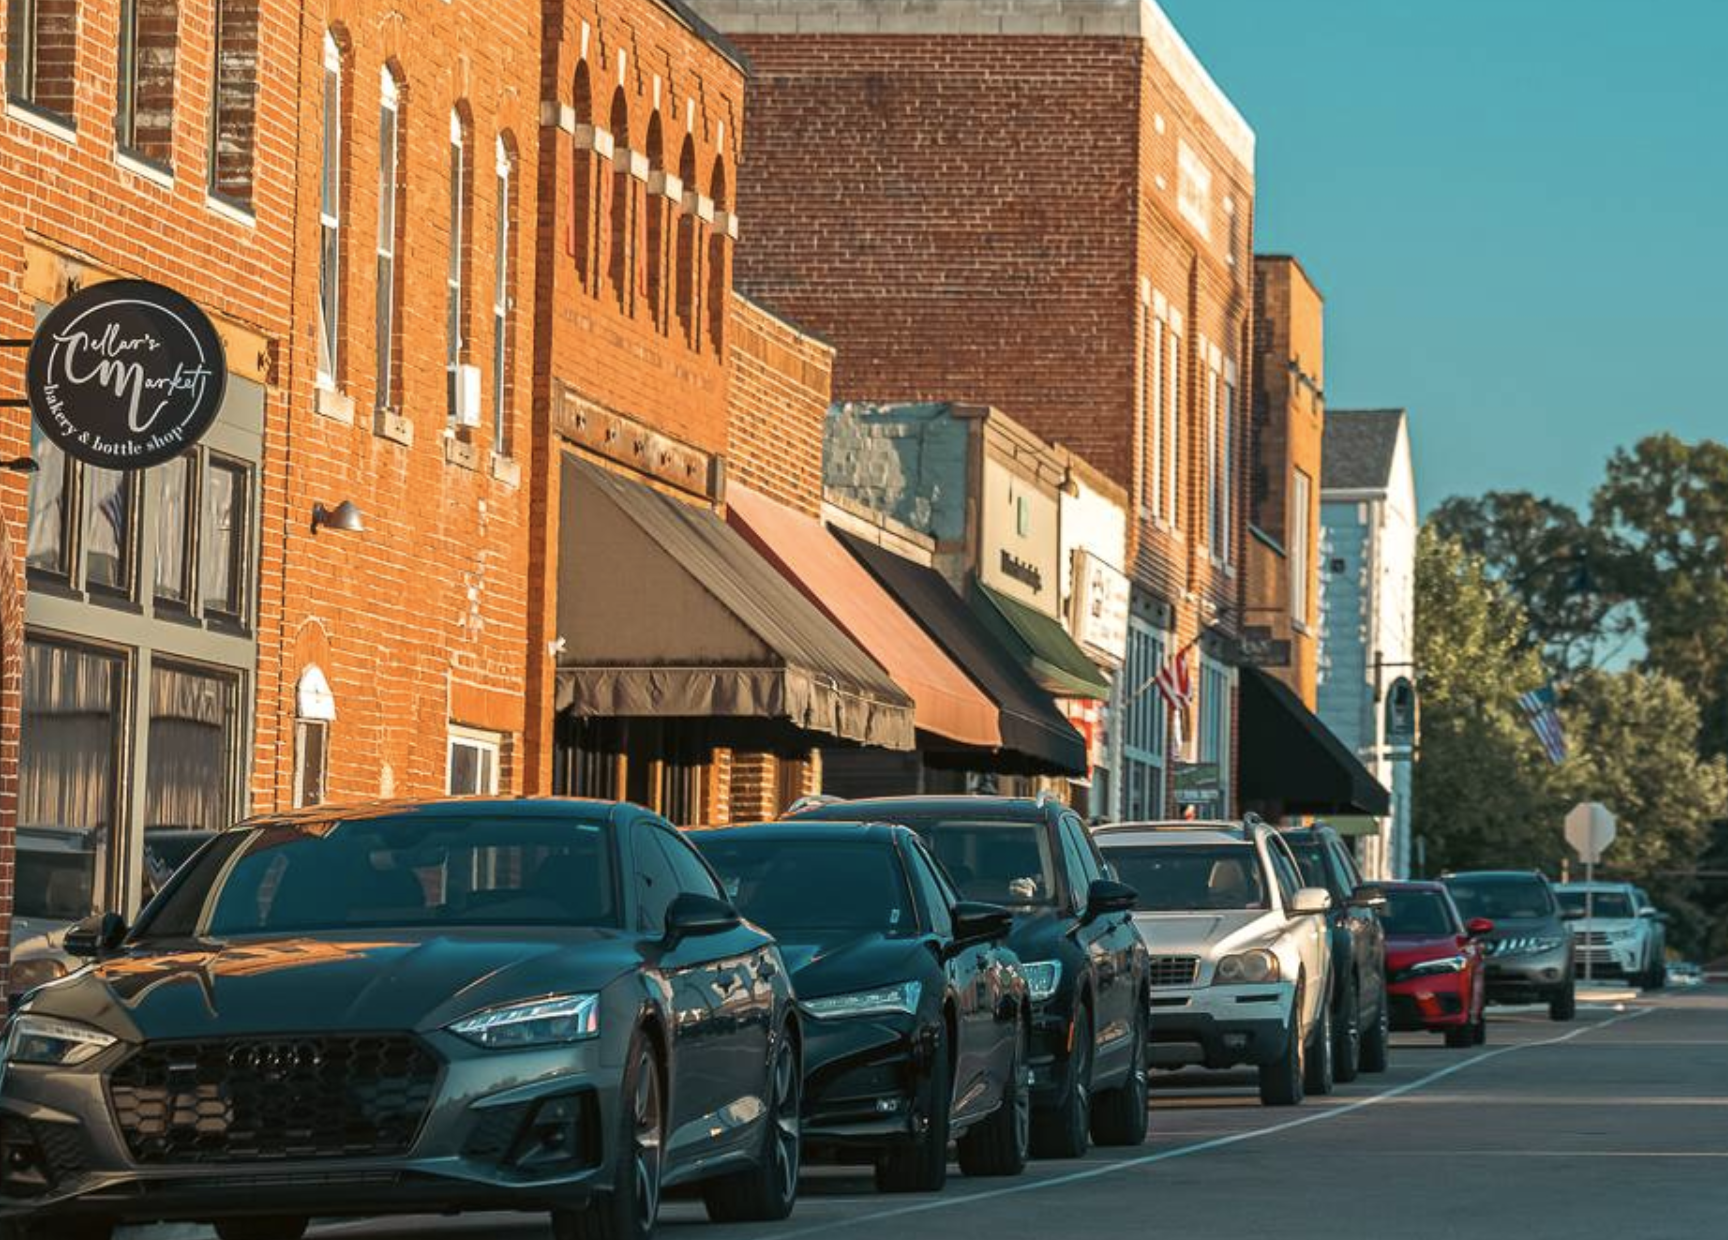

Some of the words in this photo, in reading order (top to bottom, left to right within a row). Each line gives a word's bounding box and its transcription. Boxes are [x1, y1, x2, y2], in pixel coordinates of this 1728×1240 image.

[53, 323, 160, 384] Cellar's
[43, 383, 77, 437] bakery
[78, 430, 91, 445] &
[92, 434, 143, 457] bottle
[146, 424, 185, 451] shop
[99, 359, 212, 433] Market
